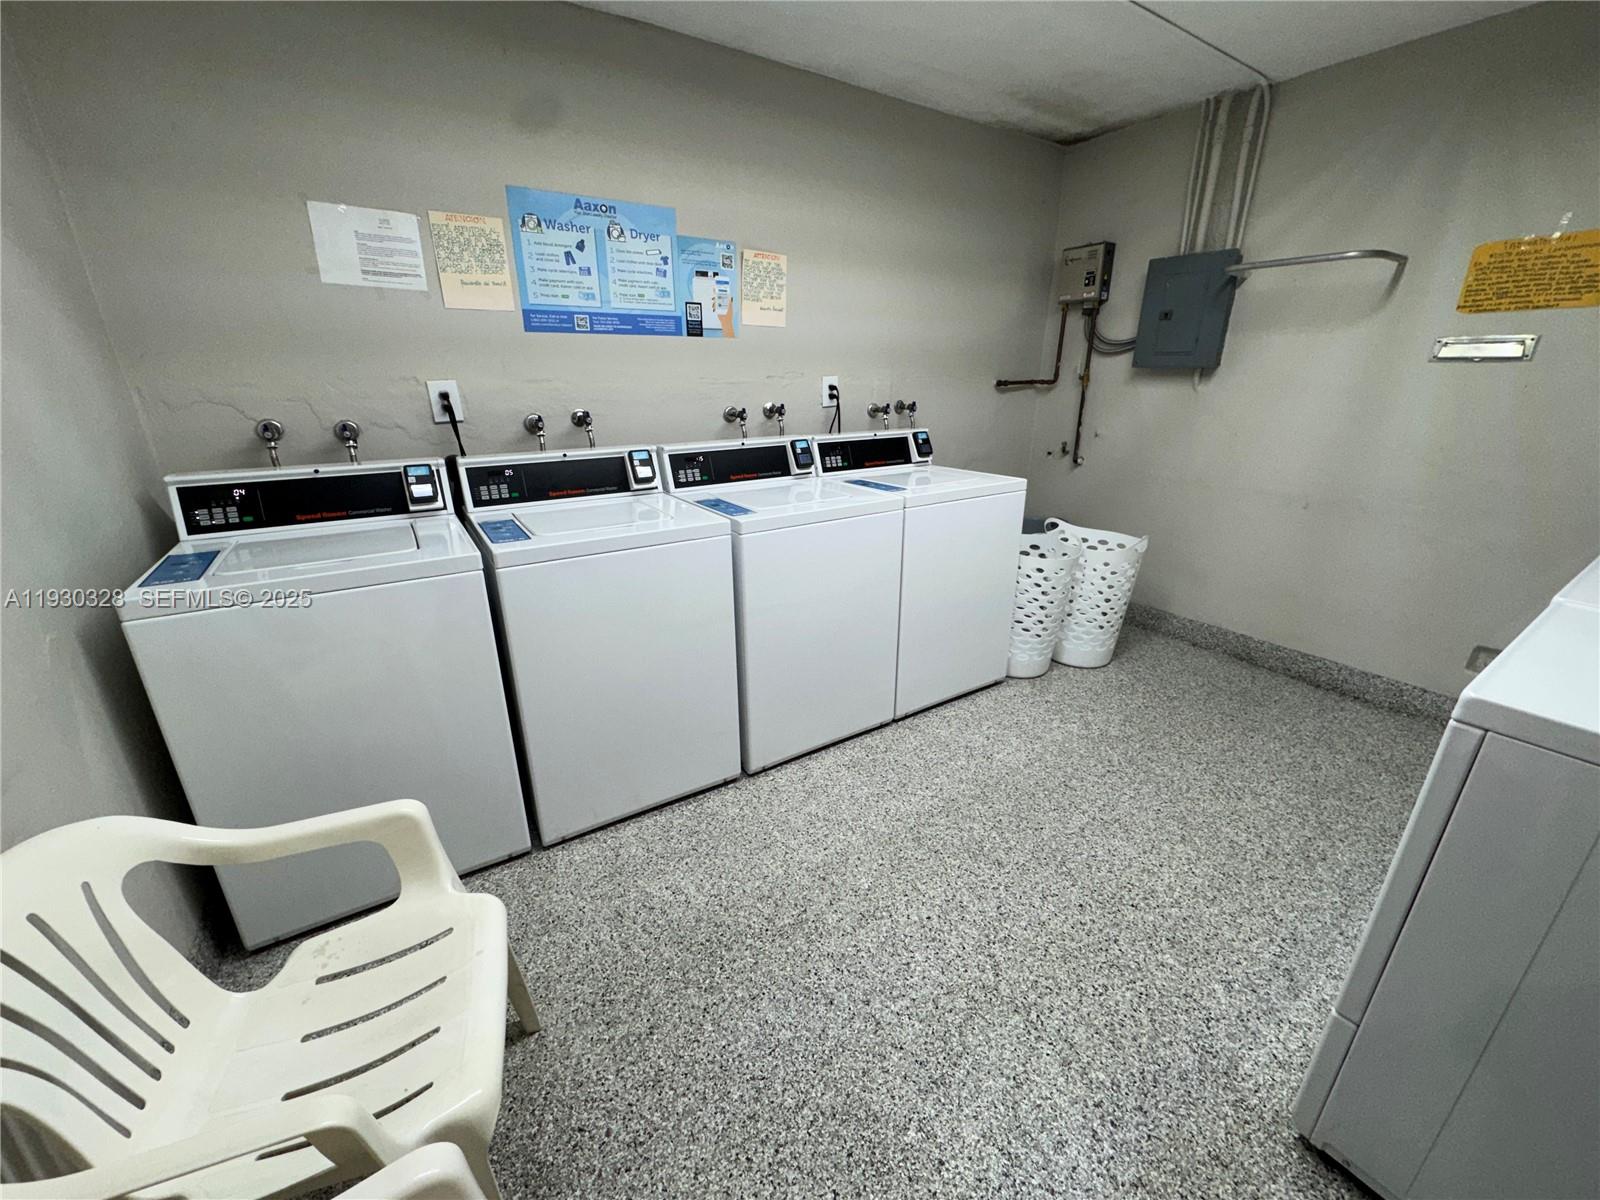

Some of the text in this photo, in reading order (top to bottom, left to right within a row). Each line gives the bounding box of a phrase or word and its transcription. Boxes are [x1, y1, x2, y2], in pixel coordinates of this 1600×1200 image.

[574, 198, 617, 215] Aaxon
[543, 218, 591, 235] Washer
[630, 228, 661, 244] Dryer
[233, 488, 245, 496] 04
[295, 512, 321, 521] Speed
